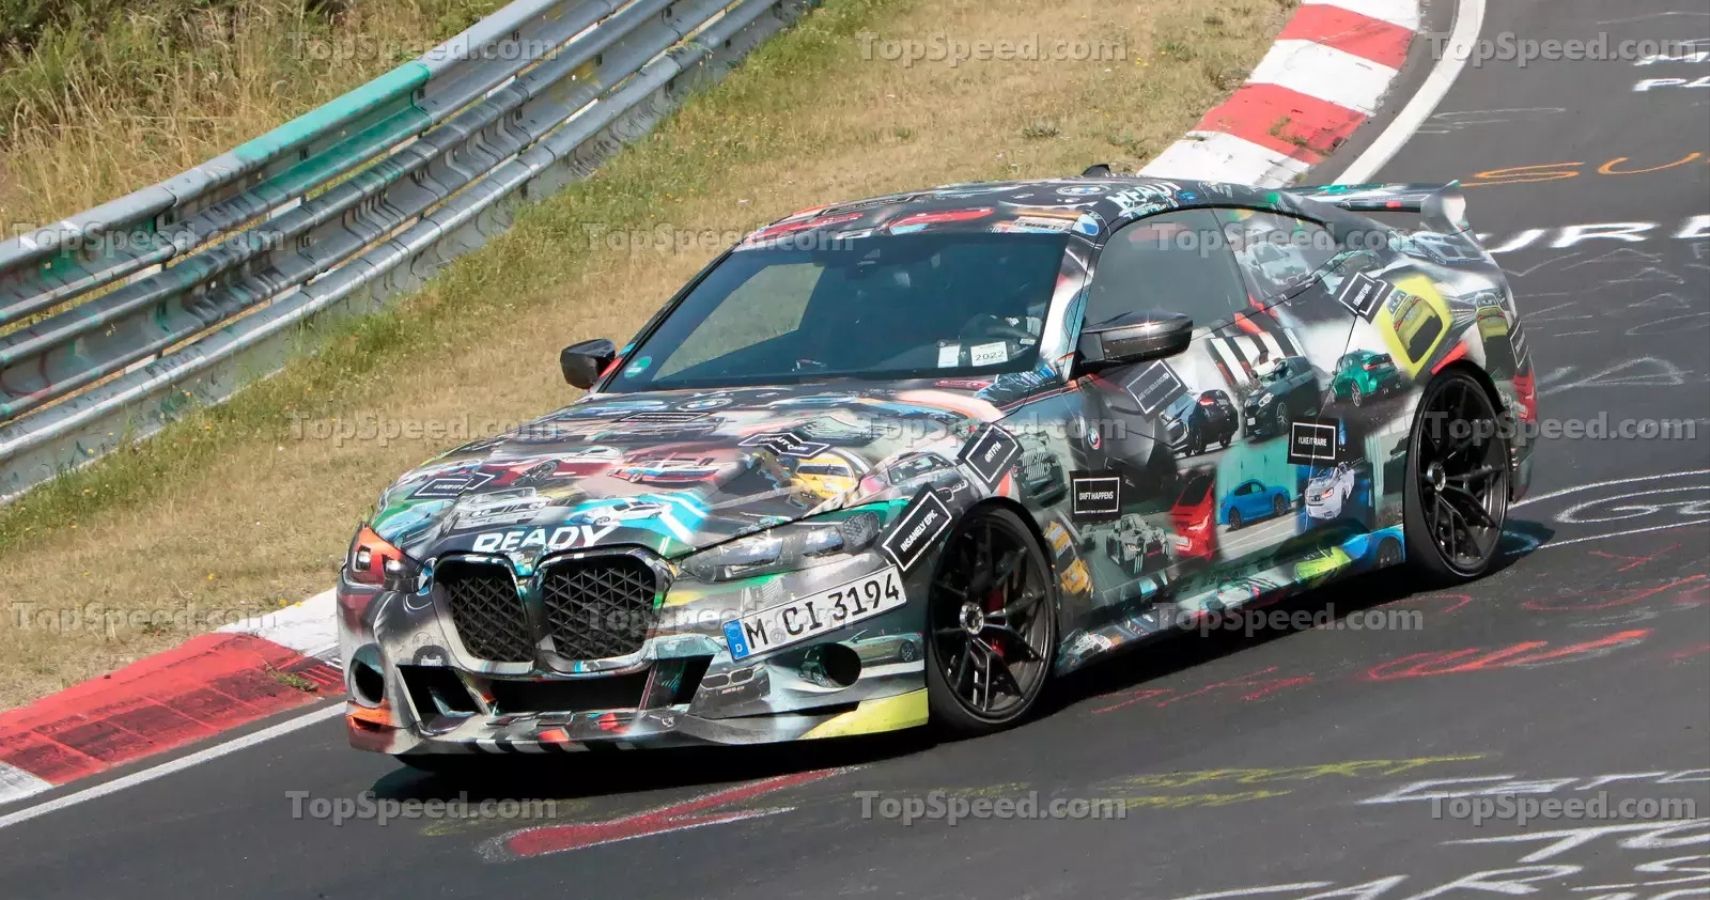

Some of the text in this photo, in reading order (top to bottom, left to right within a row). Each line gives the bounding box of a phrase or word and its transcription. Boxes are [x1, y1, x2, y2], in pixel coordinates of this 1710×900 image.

[976, 351, 1004, 361] 2022
[1091, 491, 1114, 500] HAPPENS
[472, 525, 622, 553] READY
[900, 509, 938, 552] INSANELY EPIC
[744, 618, 768, 649] M
[782, 601, 823, 636] CI
[828, 574, 900, 621] 3194
